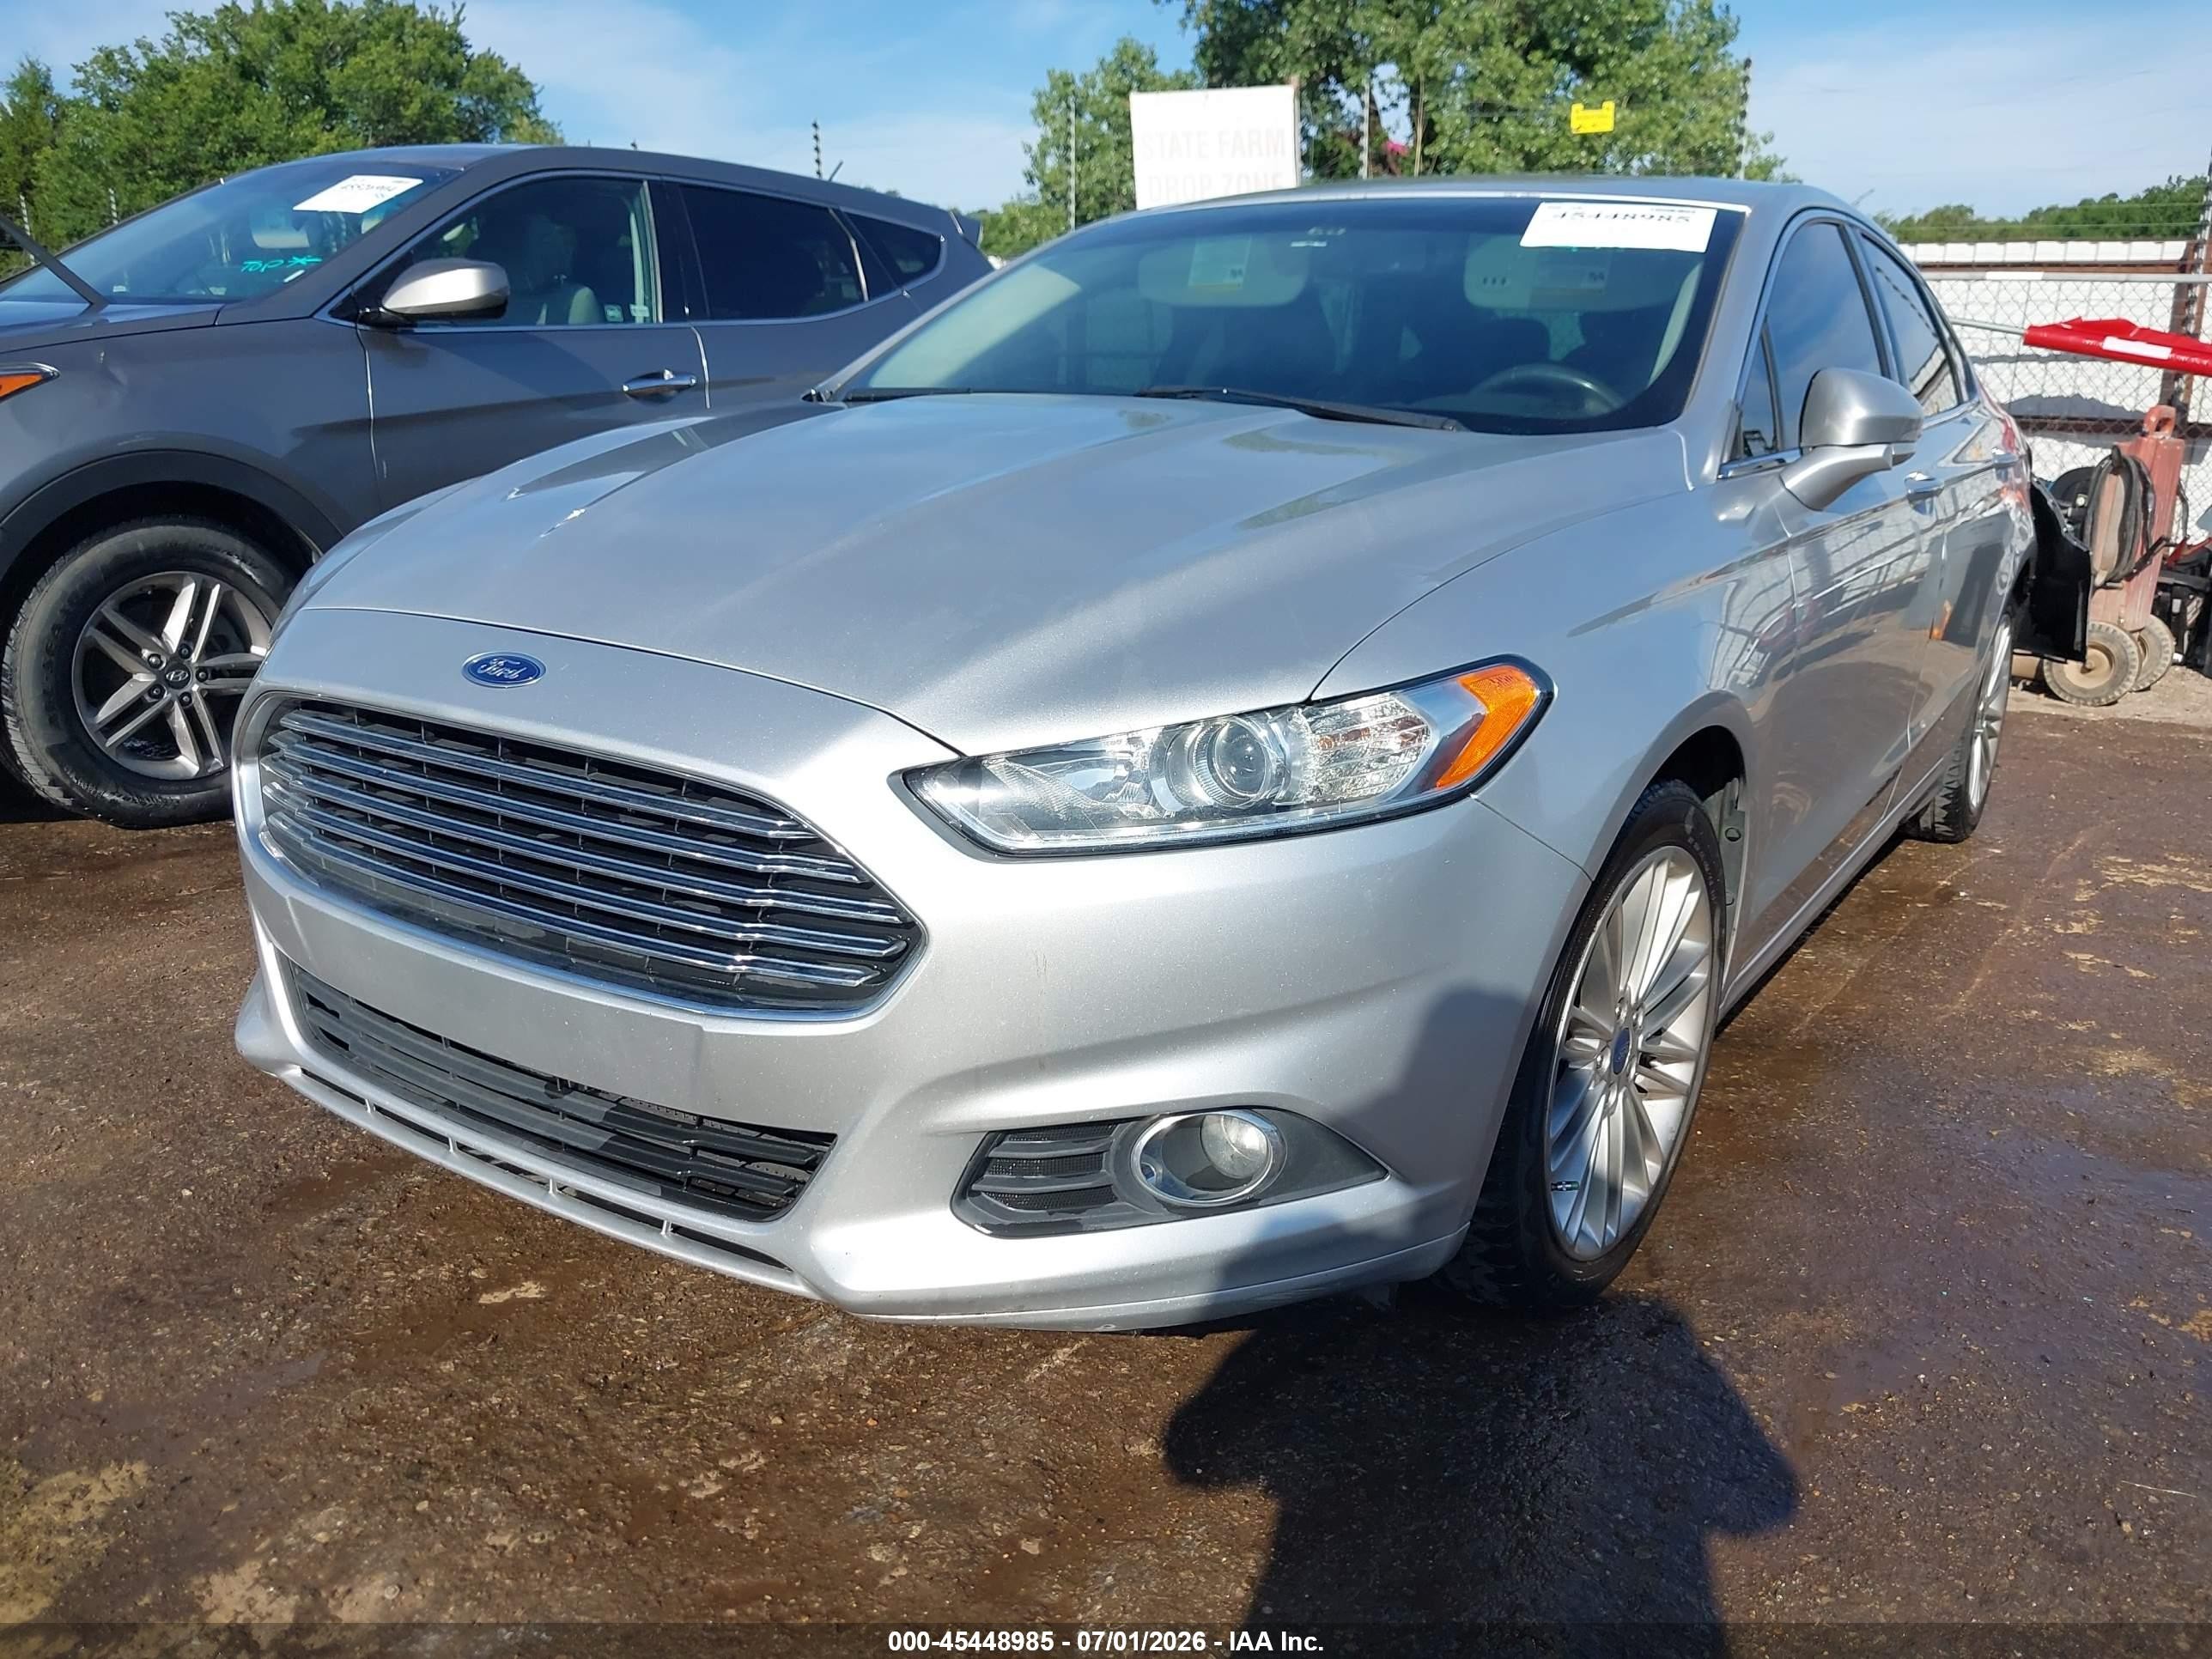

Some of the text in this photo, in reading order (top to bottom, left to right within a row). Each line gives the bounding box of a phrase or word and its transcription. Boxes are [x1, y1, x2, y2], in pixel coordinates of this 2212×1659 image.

[1141, 127, 1285, 159] STATE FARM
[1147, 173, 1212, 200] DROP
[477, 658, 526, 679] Ford
